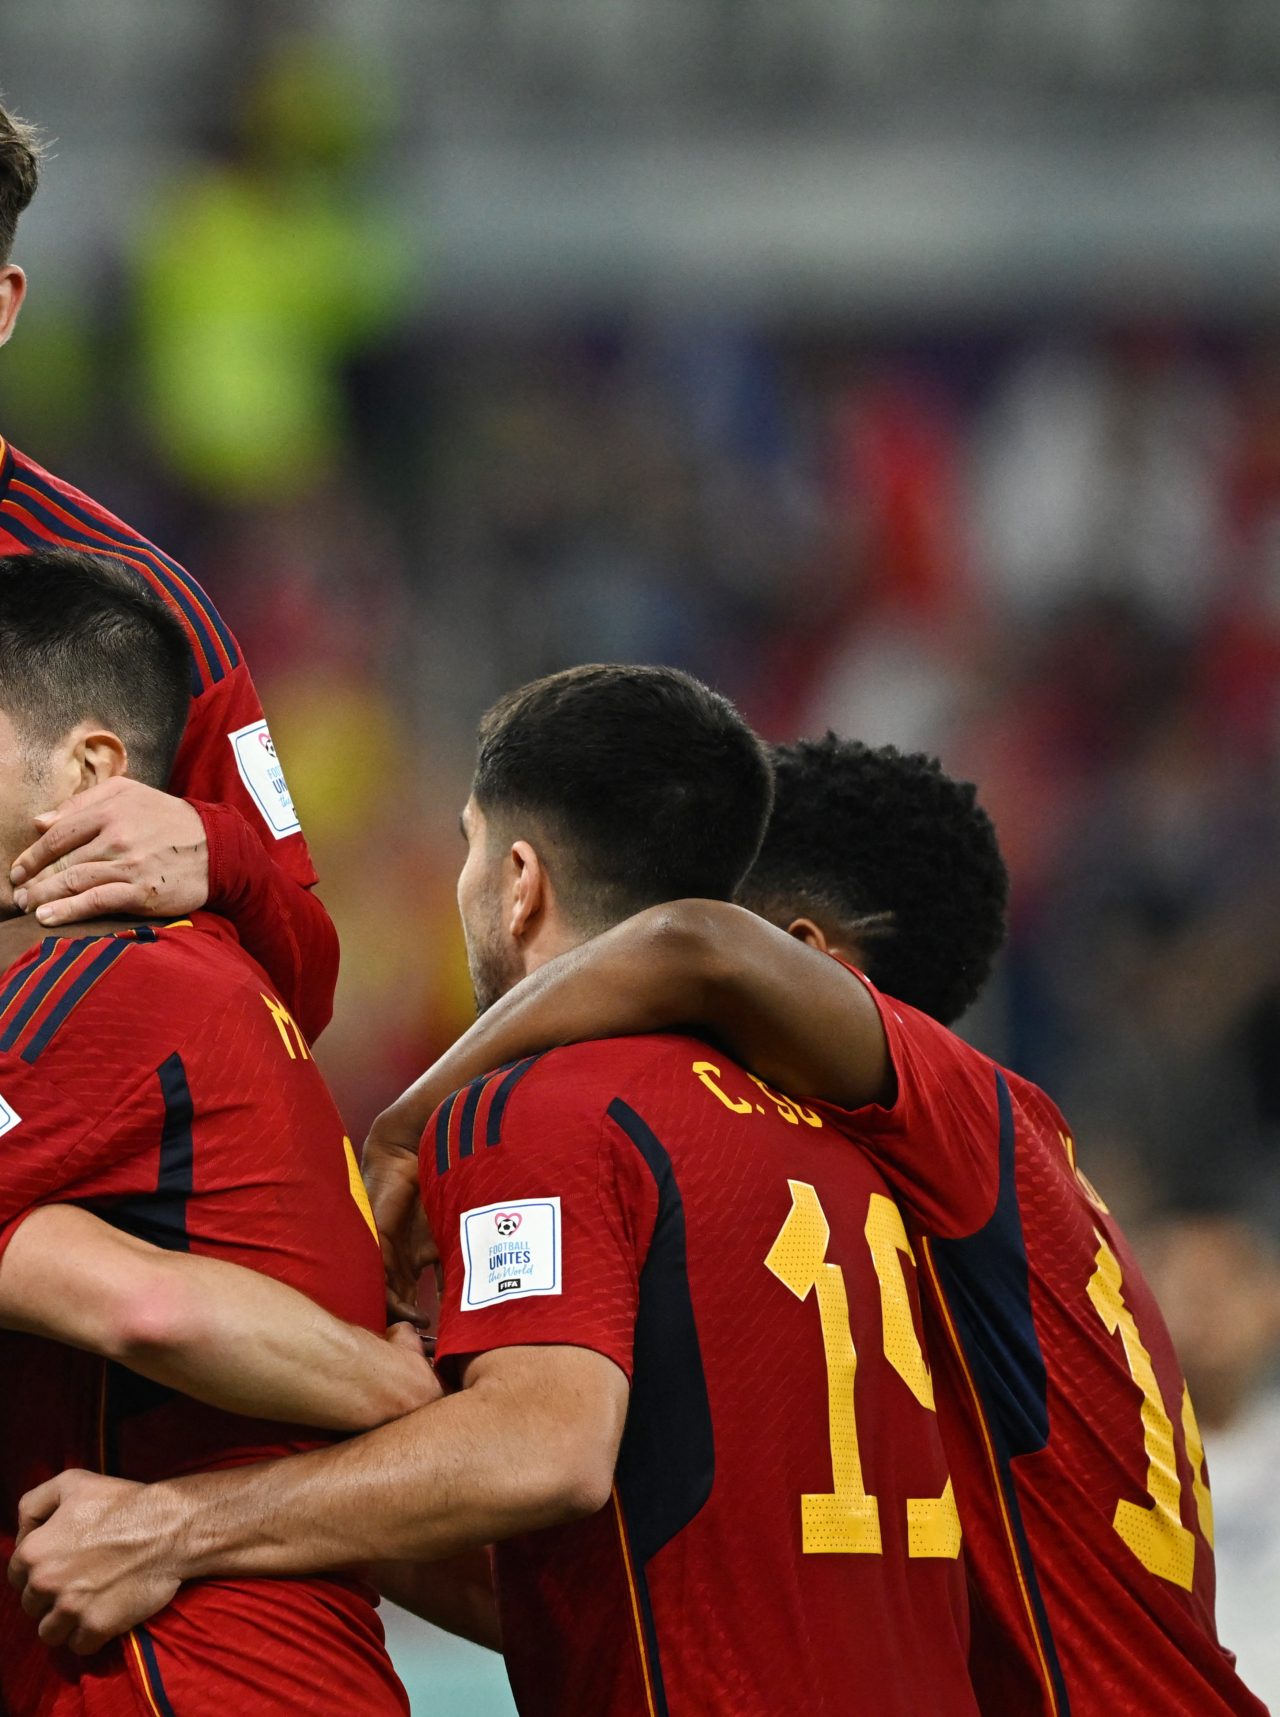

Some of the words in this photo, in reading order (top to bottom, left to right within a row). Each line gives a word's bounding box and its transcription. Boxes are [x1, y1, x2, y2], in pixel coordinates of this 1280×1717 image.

[489, 1241, 531, 1257] FOOTBALL
[489, 1250, 531, 1271] UNITES
[488, 1269, 502, 1284] the
[502, 1264, 534, 1279] World
[500, 1281, 519, 1291] FIFA
